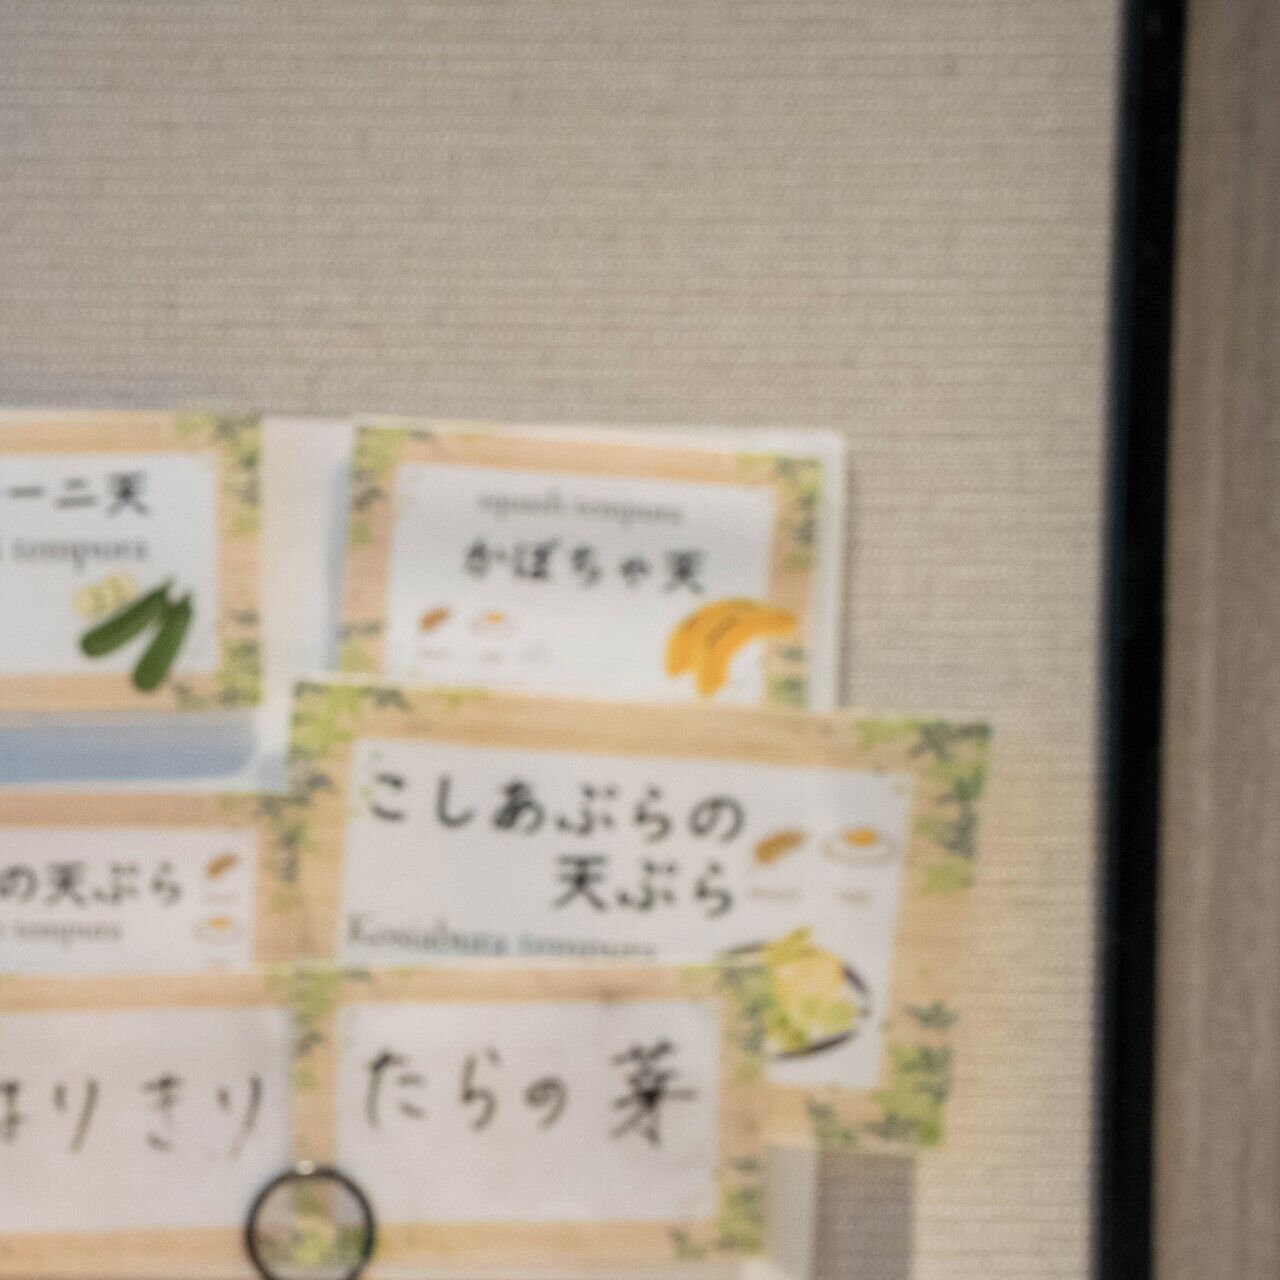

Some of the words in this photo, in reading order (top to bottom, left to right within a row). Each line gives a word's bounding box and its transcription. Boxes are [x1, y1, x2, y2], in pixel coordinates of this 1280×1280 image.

[367, 772, 744, 841] こしあぶらの
[554, 855, 735, 917] 天ぷら
